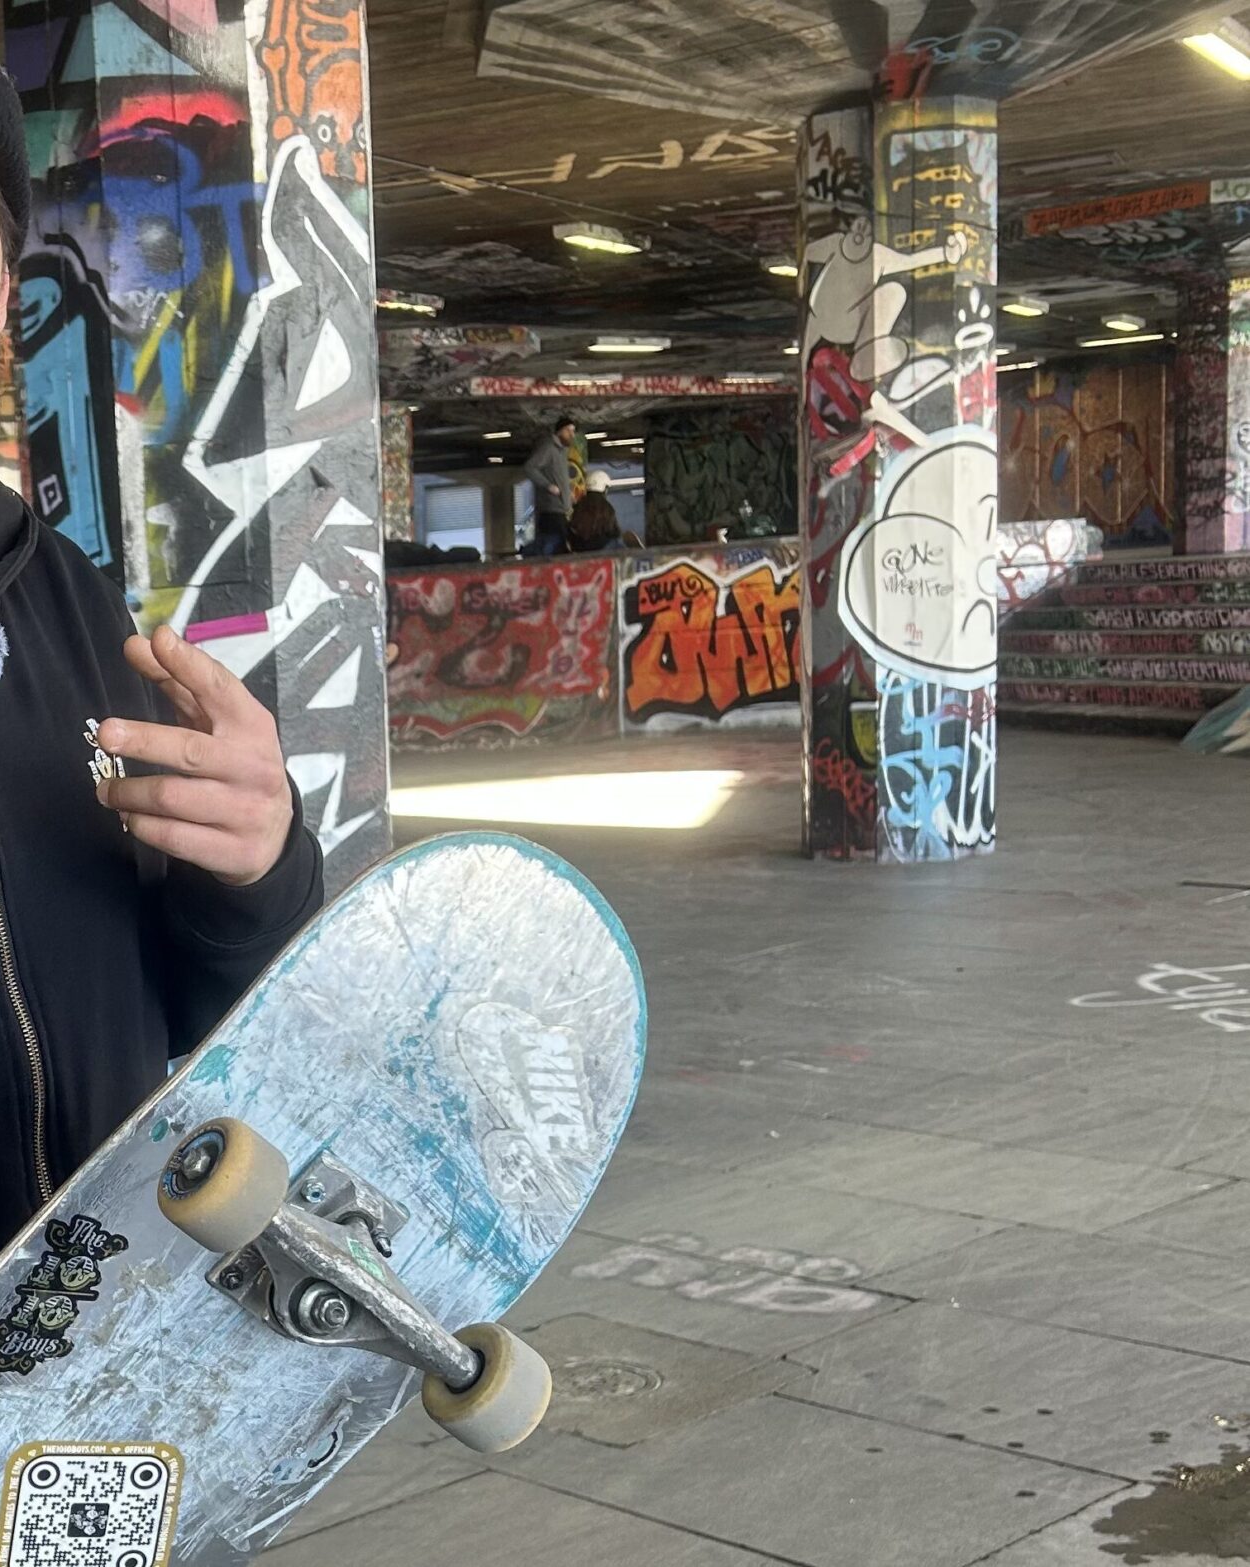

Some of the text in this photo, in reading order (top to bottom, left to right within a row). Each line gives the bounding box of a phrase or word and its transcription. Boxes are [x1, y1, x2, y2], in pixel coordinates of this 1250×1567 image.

[517, 1028, 591, 1152] NIKE
[67, 1218, 108, 1256] The
[0, 1330, 61, 1358] Boys
[124, 1445, 156, 1455] OFFICIAL
[9, 1476, 20, 1490] THE
